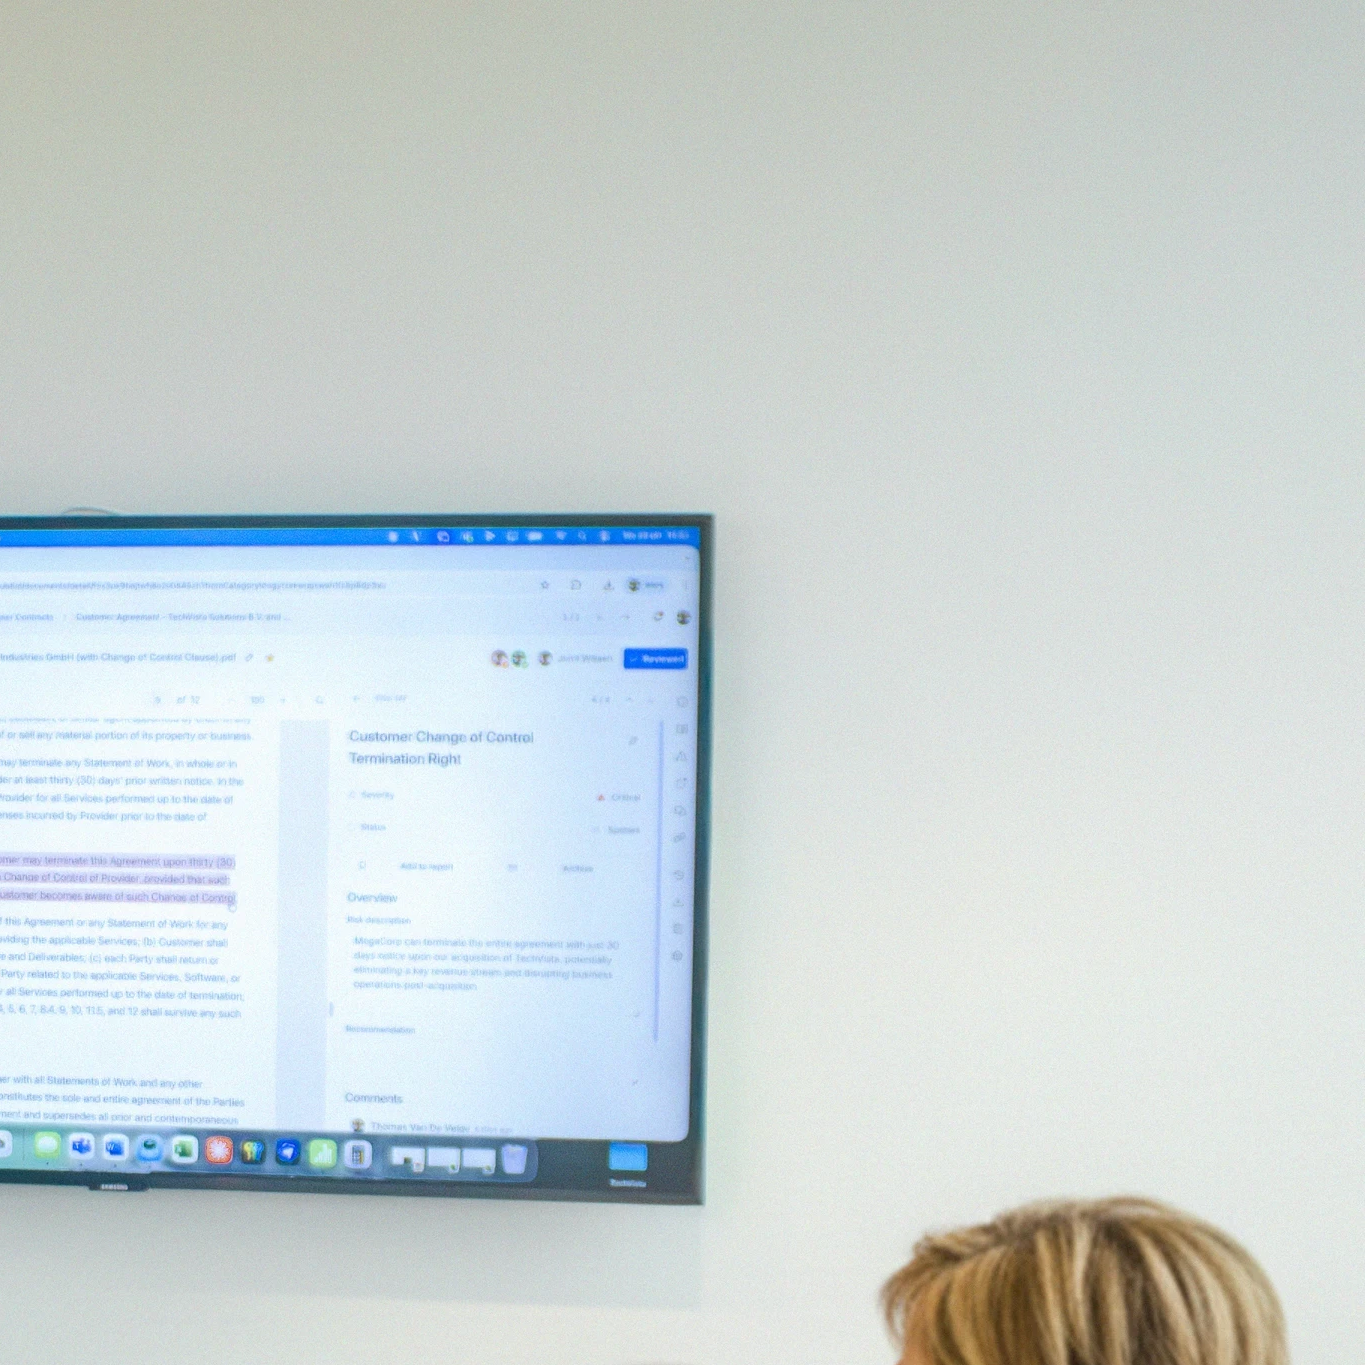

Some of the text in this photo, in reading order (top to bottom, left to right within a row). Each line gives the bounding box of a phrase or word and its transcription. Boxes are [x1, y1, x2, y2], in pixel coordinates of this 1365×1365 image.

[349, 730, 534, 746] Customer Change of Control
[19, 758, 63, 767] terminate
[65, 760, 83, 769] any
[84, 758, 132, 767] Statement
[186, 759, 214, 768] whole
[348, 752, 462, 768] Termination Right
[25, 811, 64, 820] incurred
[80, 811, 119, 820] Provider
[120, 812, 143, 823] prior
[156, 812, 172, 821] the
[174, 813, 195, 821] date
[22, 857, 43, 866] may
[44, 855, 89, 865] terminate
[90, 856, 108, 865] this
[109, 856, 161, 868] Agreement
[163, 859, 187, 868] upon
[189, 857, 214, 868] thirty
[347, 892, 398, 903] Overview
[5, 917, 22, 926] this
[24, 917, 75, 929] Agreement
[89, 920, 106, 929] any
[108, 919, 155, 928] Statement
[169, 920, 194, 929] Work
[195, 920, 209, 929] for
[211, 922, 228, 931] any
[31, 935, 47, 944] the
[48, 935, 96, 947] applicable
[158, 937, 204, 947] Customer
[205, 938, 228, 947] shall
[8, 952, 26, 961] and
[104, 954, 127, 963] each
[129, 954, 154, 965] Party
[155, 955, 177, 964] shall
[179, 956, 207, 964] return
[13, 1075, 33, 1084] with
[34, 1076, 46, 1084] all
[47, 1076, 99, 1086] Statements
[113, 1078, 138, 1087] Work
[139, 1078, 157, 1087] and
[159, 1081, 176, 1090] any
[178, 1079, 203, 1088] other
[344, 1092, 404, 1104] Comments
